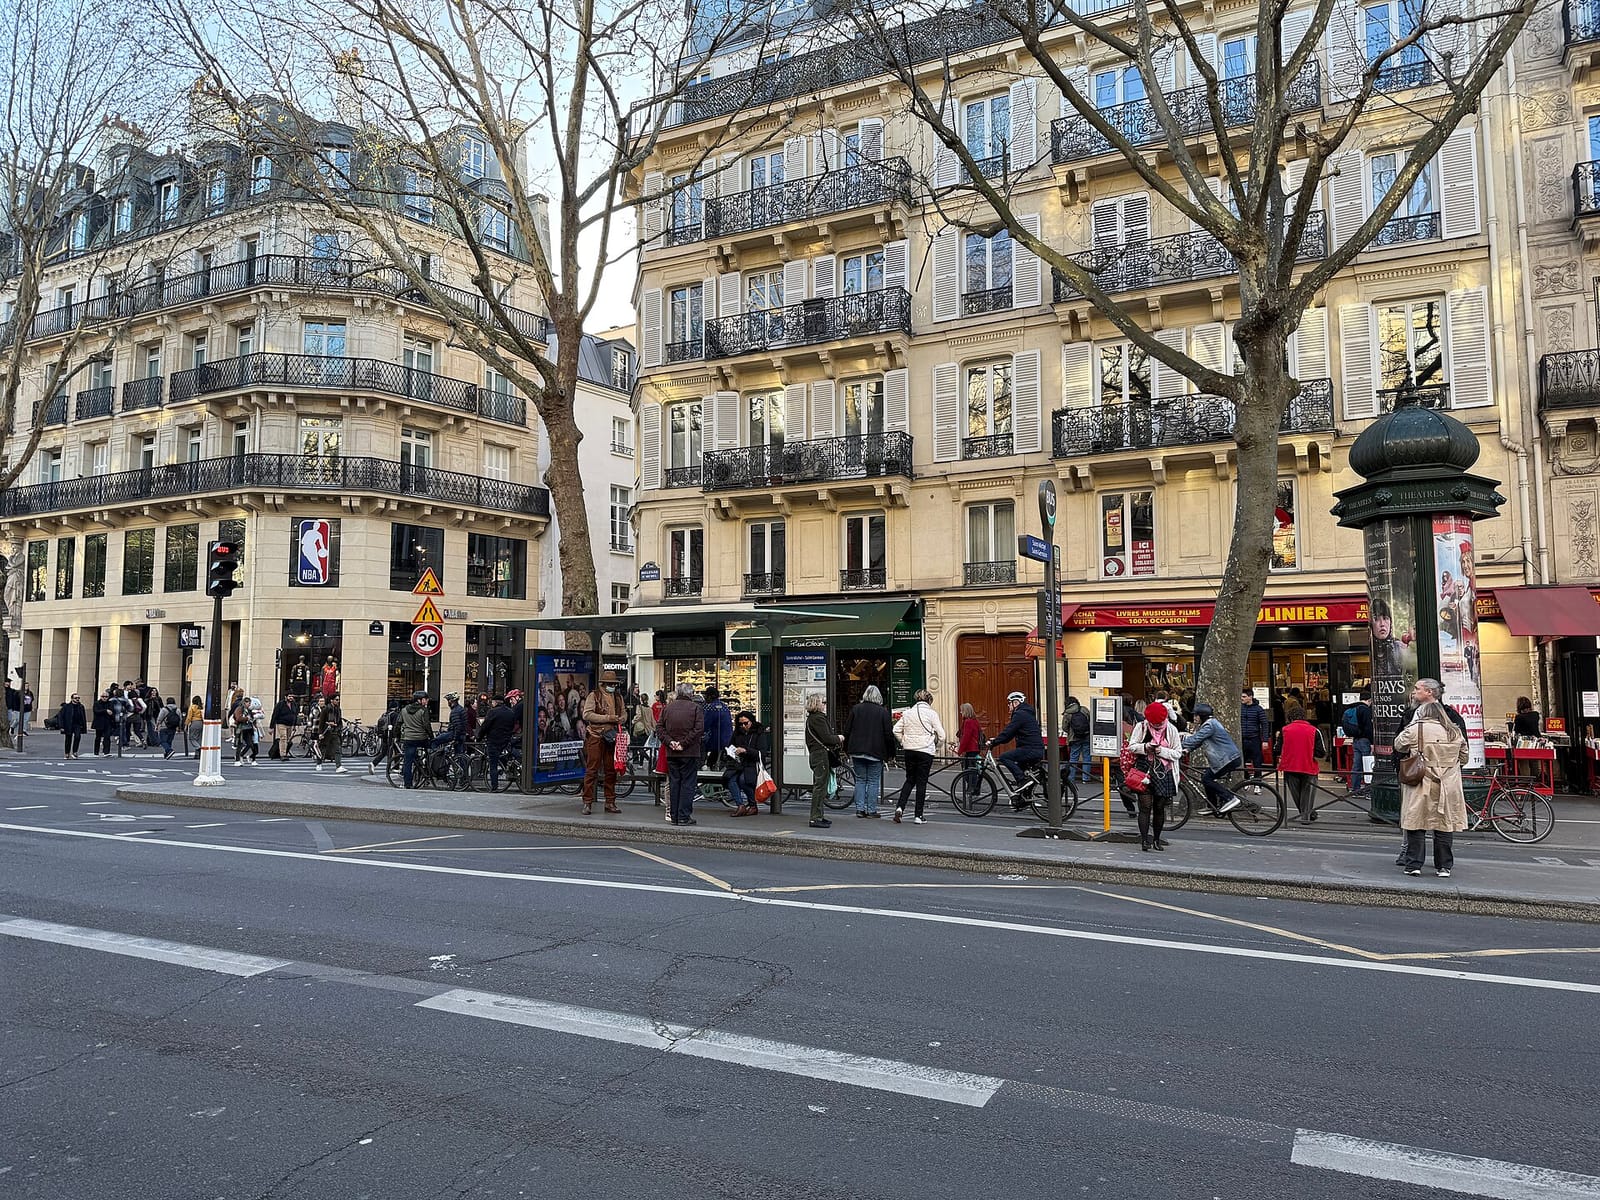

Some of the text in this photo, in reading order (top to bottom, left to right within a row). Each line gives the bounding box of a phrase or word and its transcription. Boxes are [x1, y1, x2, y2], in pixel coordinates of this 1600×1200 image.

[1046, 490, 1055, 506] BUS
[302, 569, 317, 580] NBA
[1073, 610, 1097, 618] ACHAT
[1142, 609, 1177, 618] MUSIQUE
[1178, 609, 1201, 617] FILMS
[1477, 607, 1501, 615] VENT
[418, 633, 438, 648] 30
[1378, 680, 1406, 694] PAYS
